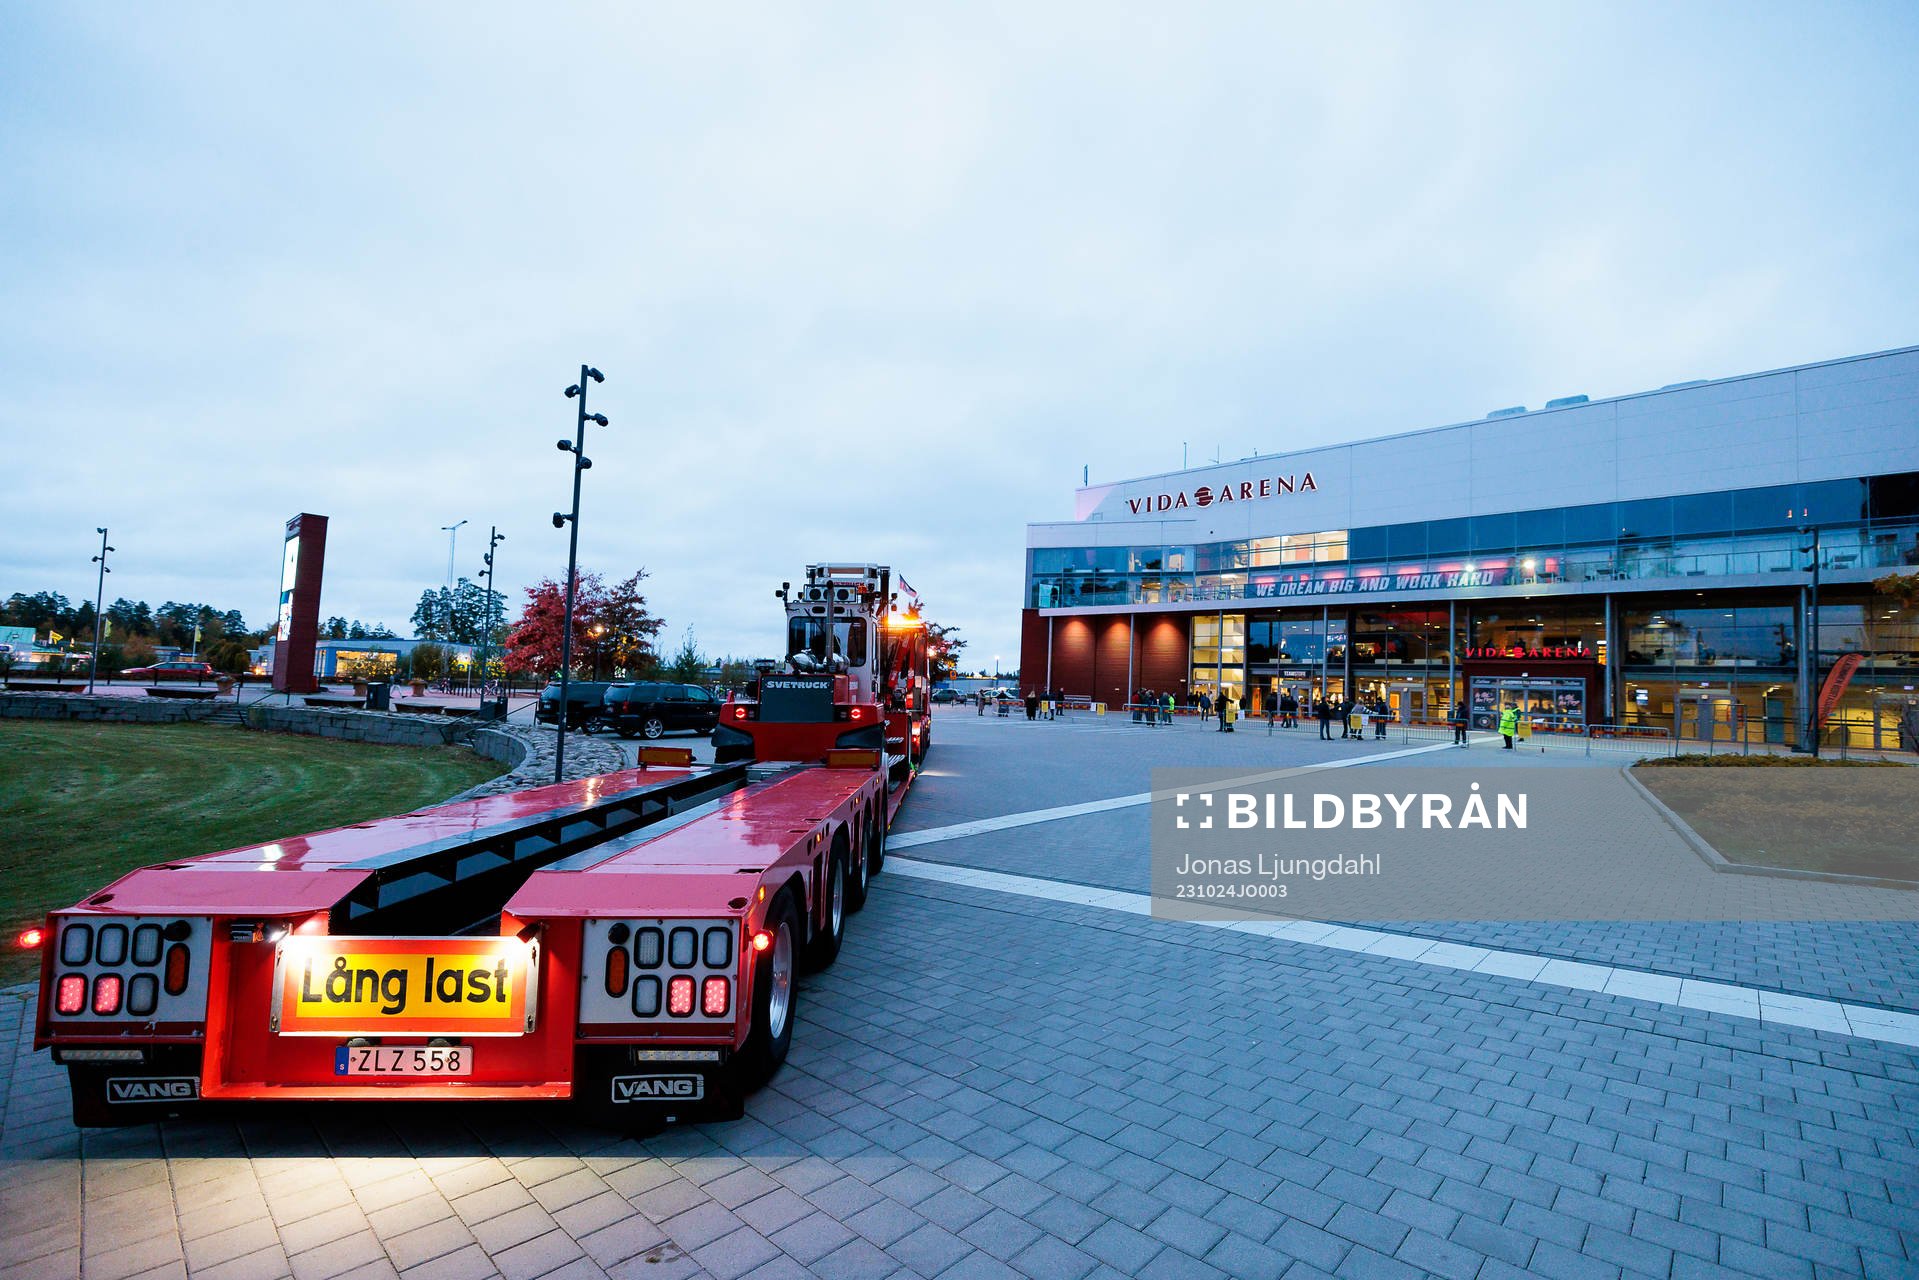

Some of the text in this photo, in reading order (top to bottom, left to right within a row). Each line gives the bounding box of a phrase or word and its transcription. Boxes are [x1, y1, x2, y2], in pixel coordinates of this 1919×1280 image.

[1129, 471, 1318, 515] VIDA ARENA
[1256, 570, 1495, 597] WE DREAM BIG AND WORK HARD
[1465, 647, 1592, 658] VIDA ARENA
[766, 681, 828, 689] SVETRUCK
[302, 956, 506, 1015] Lång last
[339, 1050, 460, 1072] S ZLZ 558
[112, 1082, 192, 1098] VANG
[617, 1080, 693, 1097] VANG
